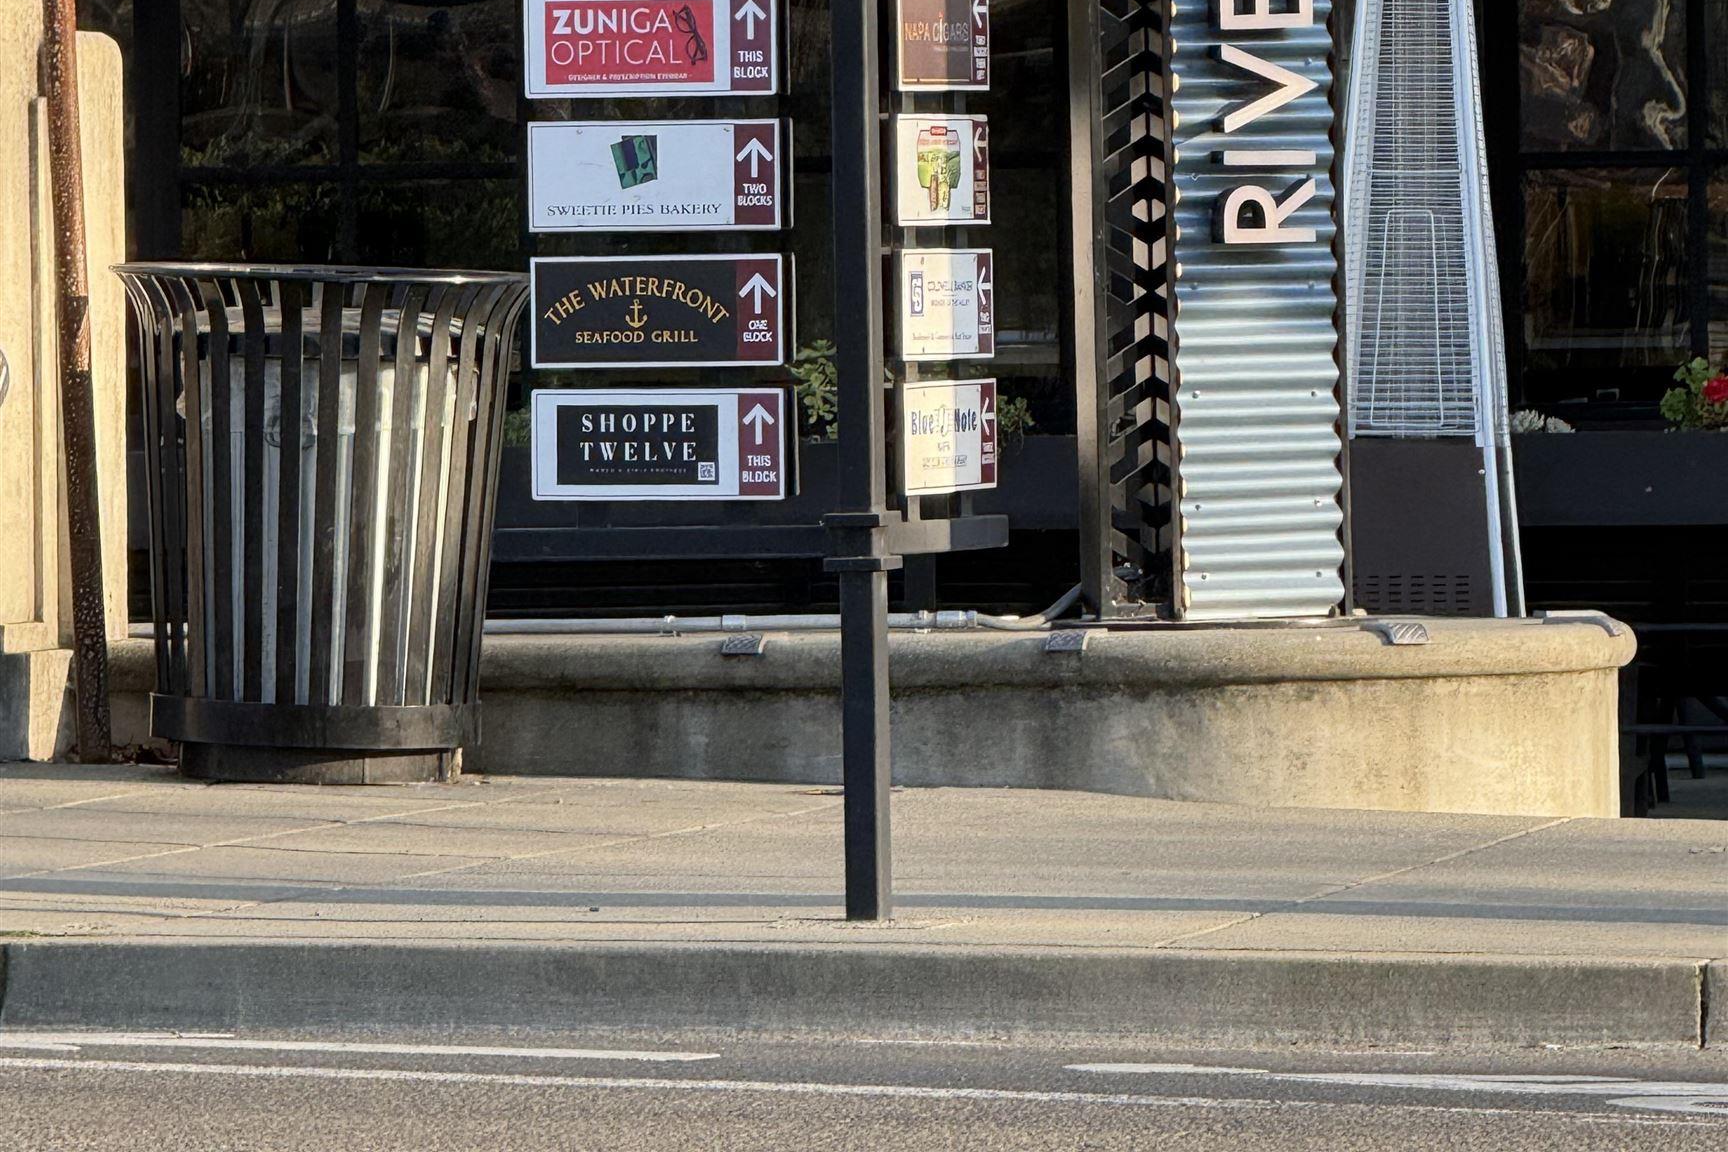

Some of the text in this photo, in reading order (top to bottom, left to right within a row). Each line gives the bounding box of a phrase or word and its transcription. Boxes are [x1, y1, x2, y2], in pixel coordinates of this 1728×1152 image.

[552, 7, 673, 35] ZUNIGA
[904, 22, 931, 42] NAPA
[551, 39, 683, 66] OPTICAL
[738, 50, 764, 63] THIS
[733, 66, 769, 79] BLOCK
[742, 184, 767, 194] TWO
[737, 195, 772, 206] BLOCKS
[547, 202, 722, 217] SWEETIE PIES BAKERY
[544, 276, 730, 326] THE WATERFRONT
[748, 320, 768, 330] ONE
[575, 330, 698, 344] SEAFOOD GRILL
[743, 331, 773, 343] BLOCK
[581, 413, 696, 434] SHOPPE
[911, 410, 934, 436] Blue
[580, 442, 697, 462] TWELVE
[748, 455, 772, 467] THIS
[742, 470, 777, 483] BLOCK
